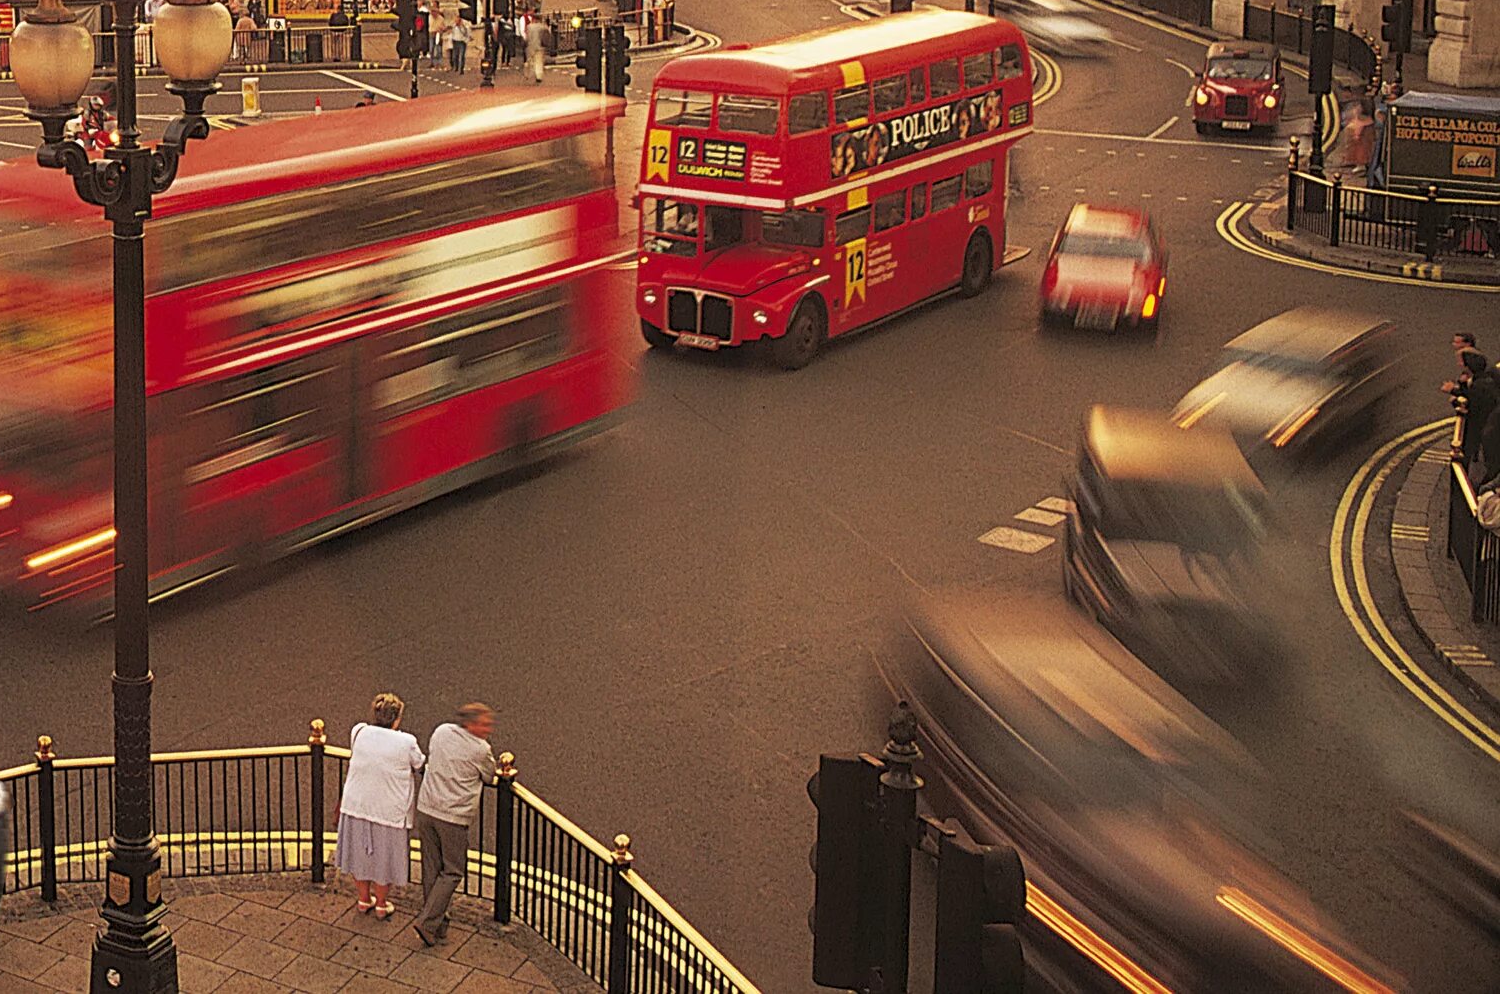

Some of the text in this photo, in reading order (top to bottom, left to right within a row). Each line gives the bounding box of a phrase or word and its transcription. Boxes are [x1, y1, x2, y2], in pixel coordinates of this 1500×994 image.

[891, 104, 950, 147] POLICE
[1396, 115, 1419, 127] ICE
[1420, 116, 1469, 132] CREAM
[1395, 126, 1420, 140] HOT
[651, 146, 668, 164] 12
[679, 140, 696, 158] 12
[849, 250, 864, 283] 12
